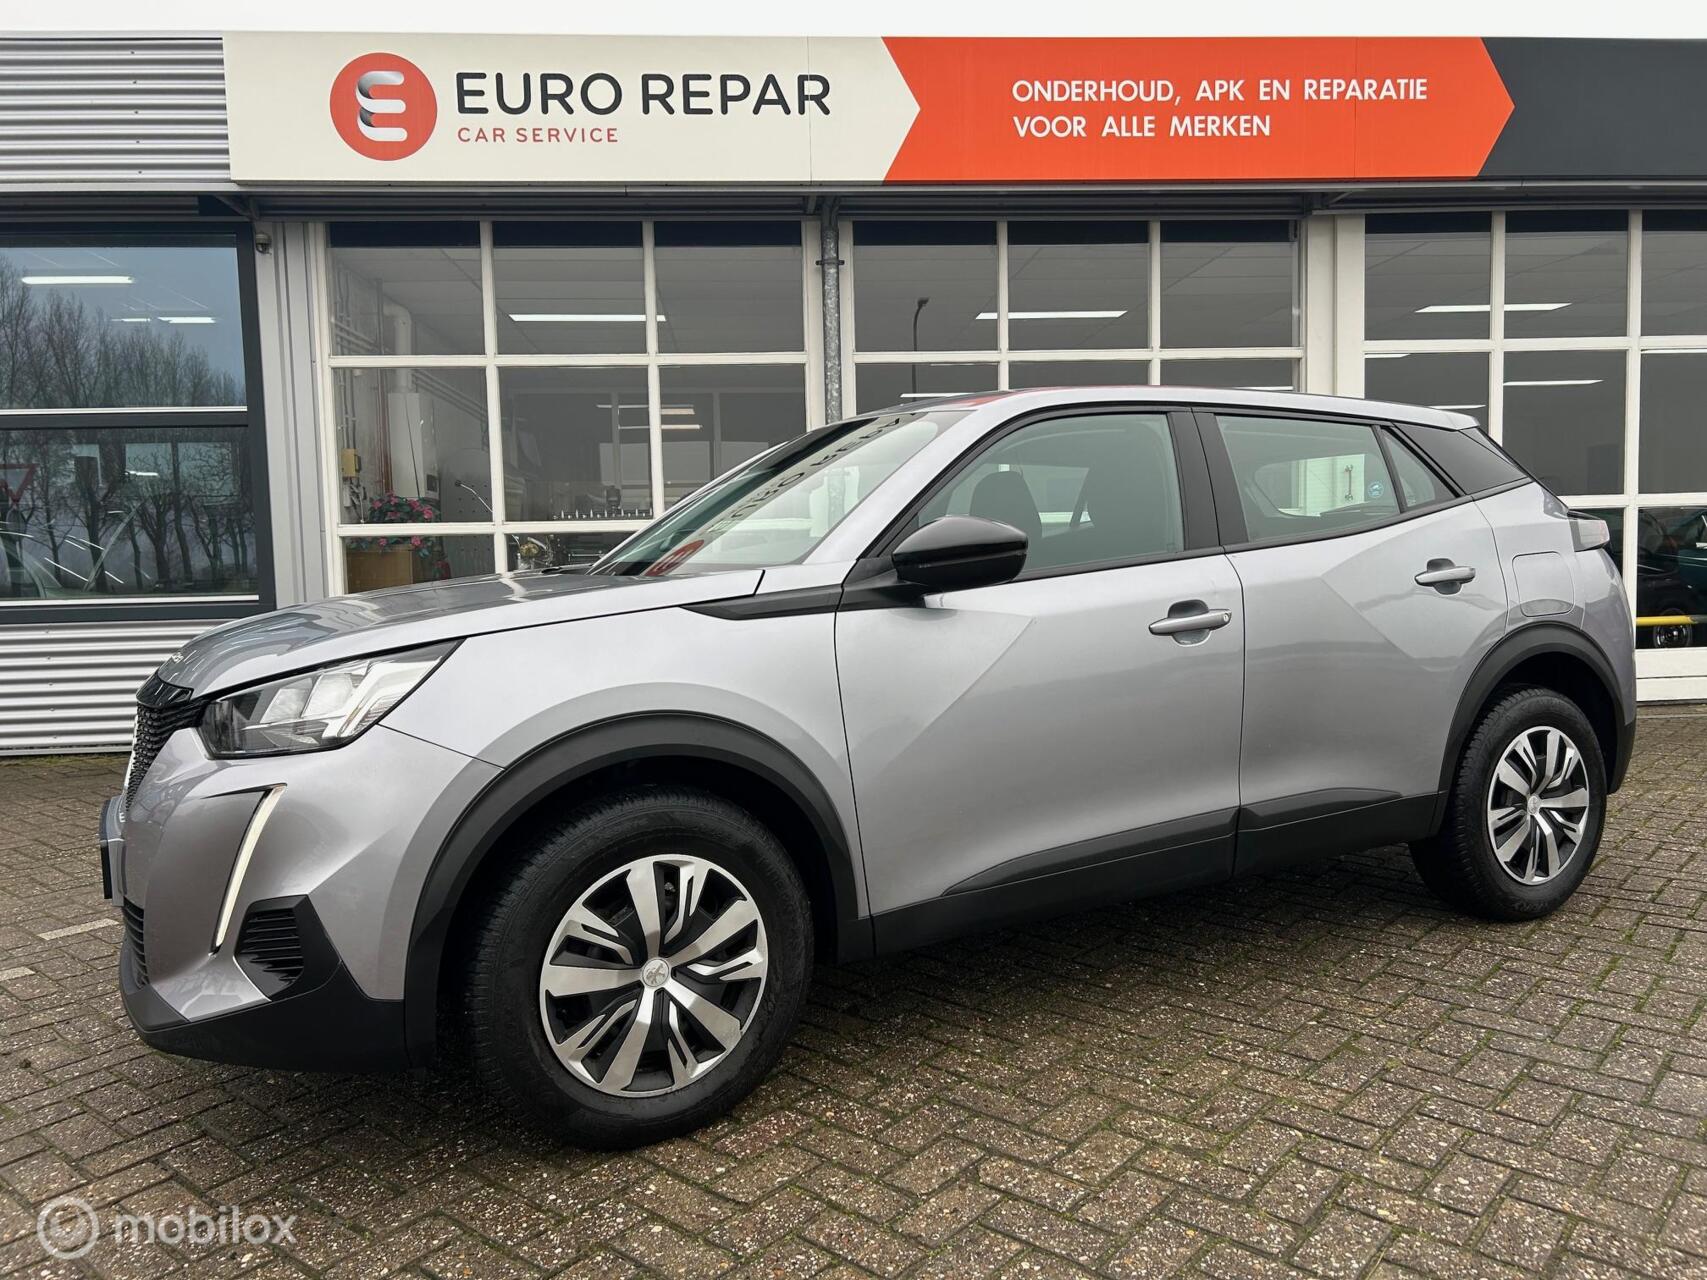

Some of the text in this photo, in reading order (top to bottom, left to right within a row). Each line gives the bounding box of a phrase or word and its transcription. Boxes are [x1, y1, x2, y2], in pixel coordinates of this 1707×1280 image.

[455, 72, 831, 116] EURO REPAR
[1012, 78, 1428, 106] ONDERHOUD, APK EN REPARATIE
[457, 127, 619, 143] CAR SERVICE
[1013, 114, 1271, 138] VOOR ALLE MERKEN
